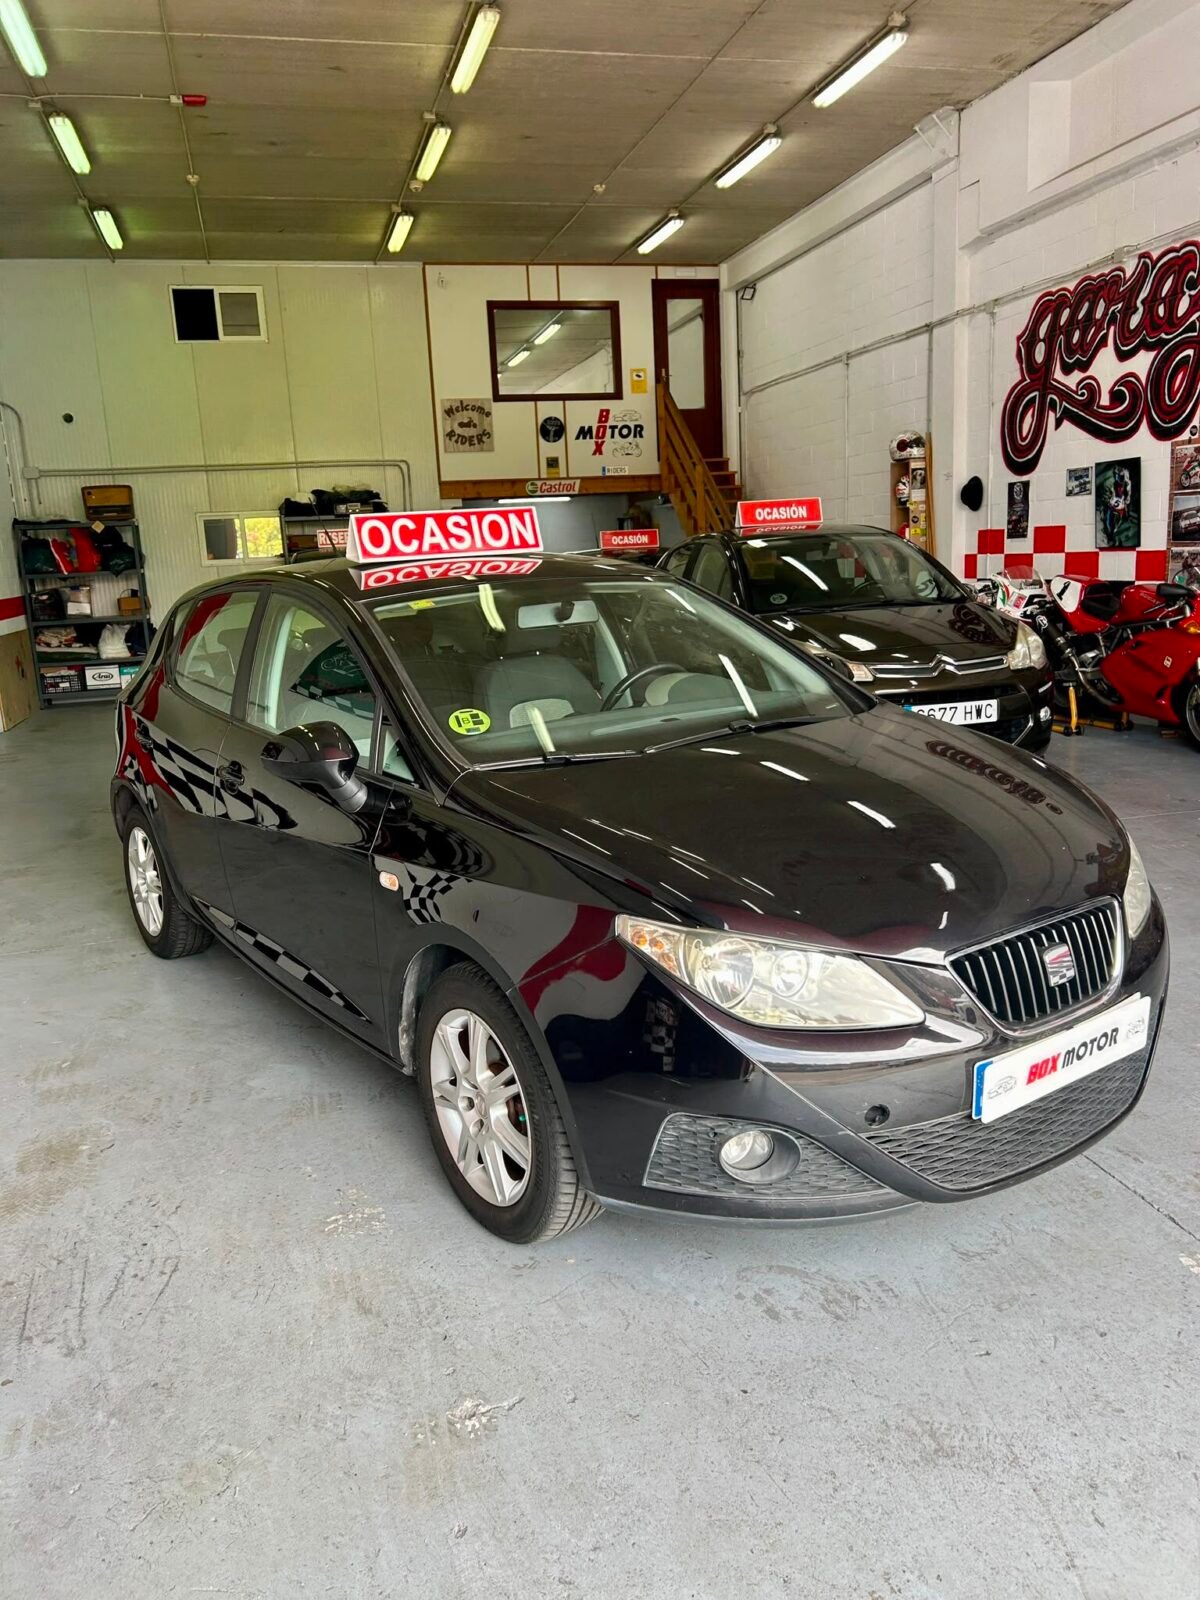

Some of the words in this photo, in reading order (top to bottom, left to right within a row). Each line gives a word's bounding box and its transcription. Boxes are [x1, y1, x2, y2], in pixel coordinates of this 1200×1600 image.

[444, 400, 492, 418] Welcome
[445, 429, 492, 447] RIDERS
[575, 424, 644, 441] MOTOR
[592, 409, 611, 456] BOX
[540, 481, 576, 494] Castrol
[755, 504, 807, 521] OCASIÓN
[360, 512, 536, 556] OCASION
[611, 534, 649, 545] OCASIÓN
[964, 703, 993, 721] HWC
[1026, 1052, 1062, 1086] BOX
[1062, 1027, 1119, 1069] MOTOR
